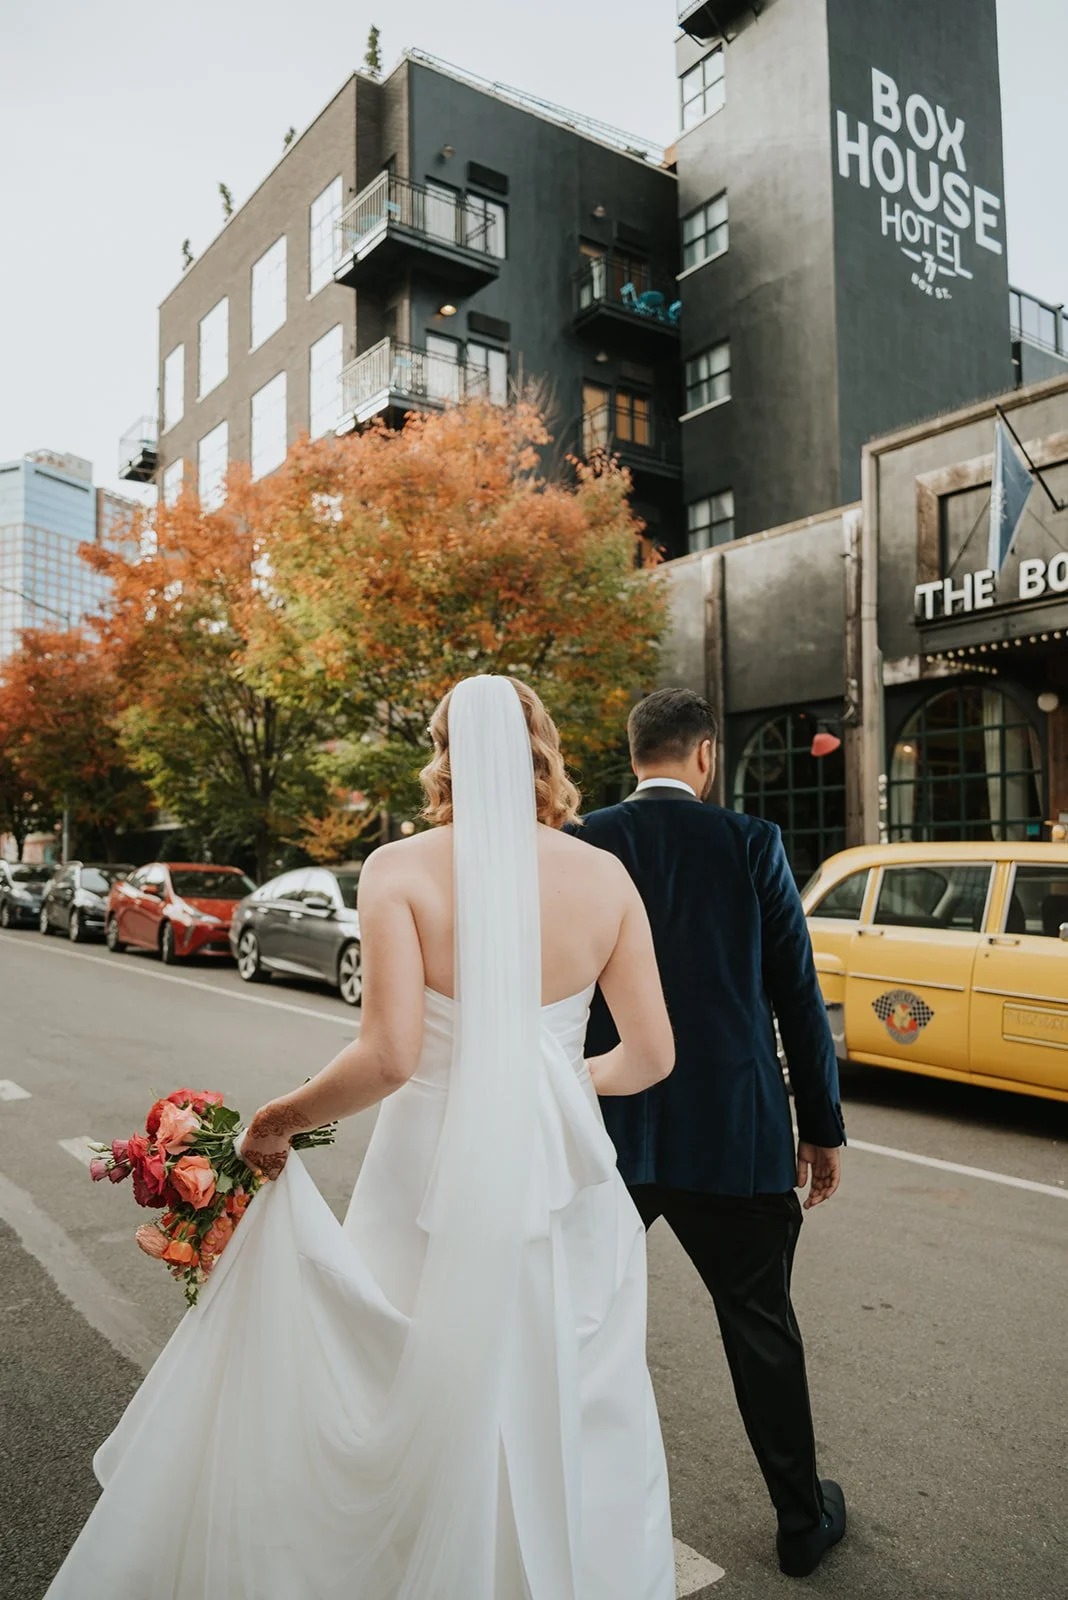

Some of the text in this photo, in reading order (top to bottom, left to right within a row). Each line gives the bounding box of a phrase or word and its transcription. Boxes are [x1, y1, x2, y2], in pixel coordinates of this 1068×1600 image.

[871, 67, 967, 172] BOX
[836, 110, 1002, 255] HOUSE
[881, 196, 973, 279] HOTEL
[915, 569, 994, 620] THE
